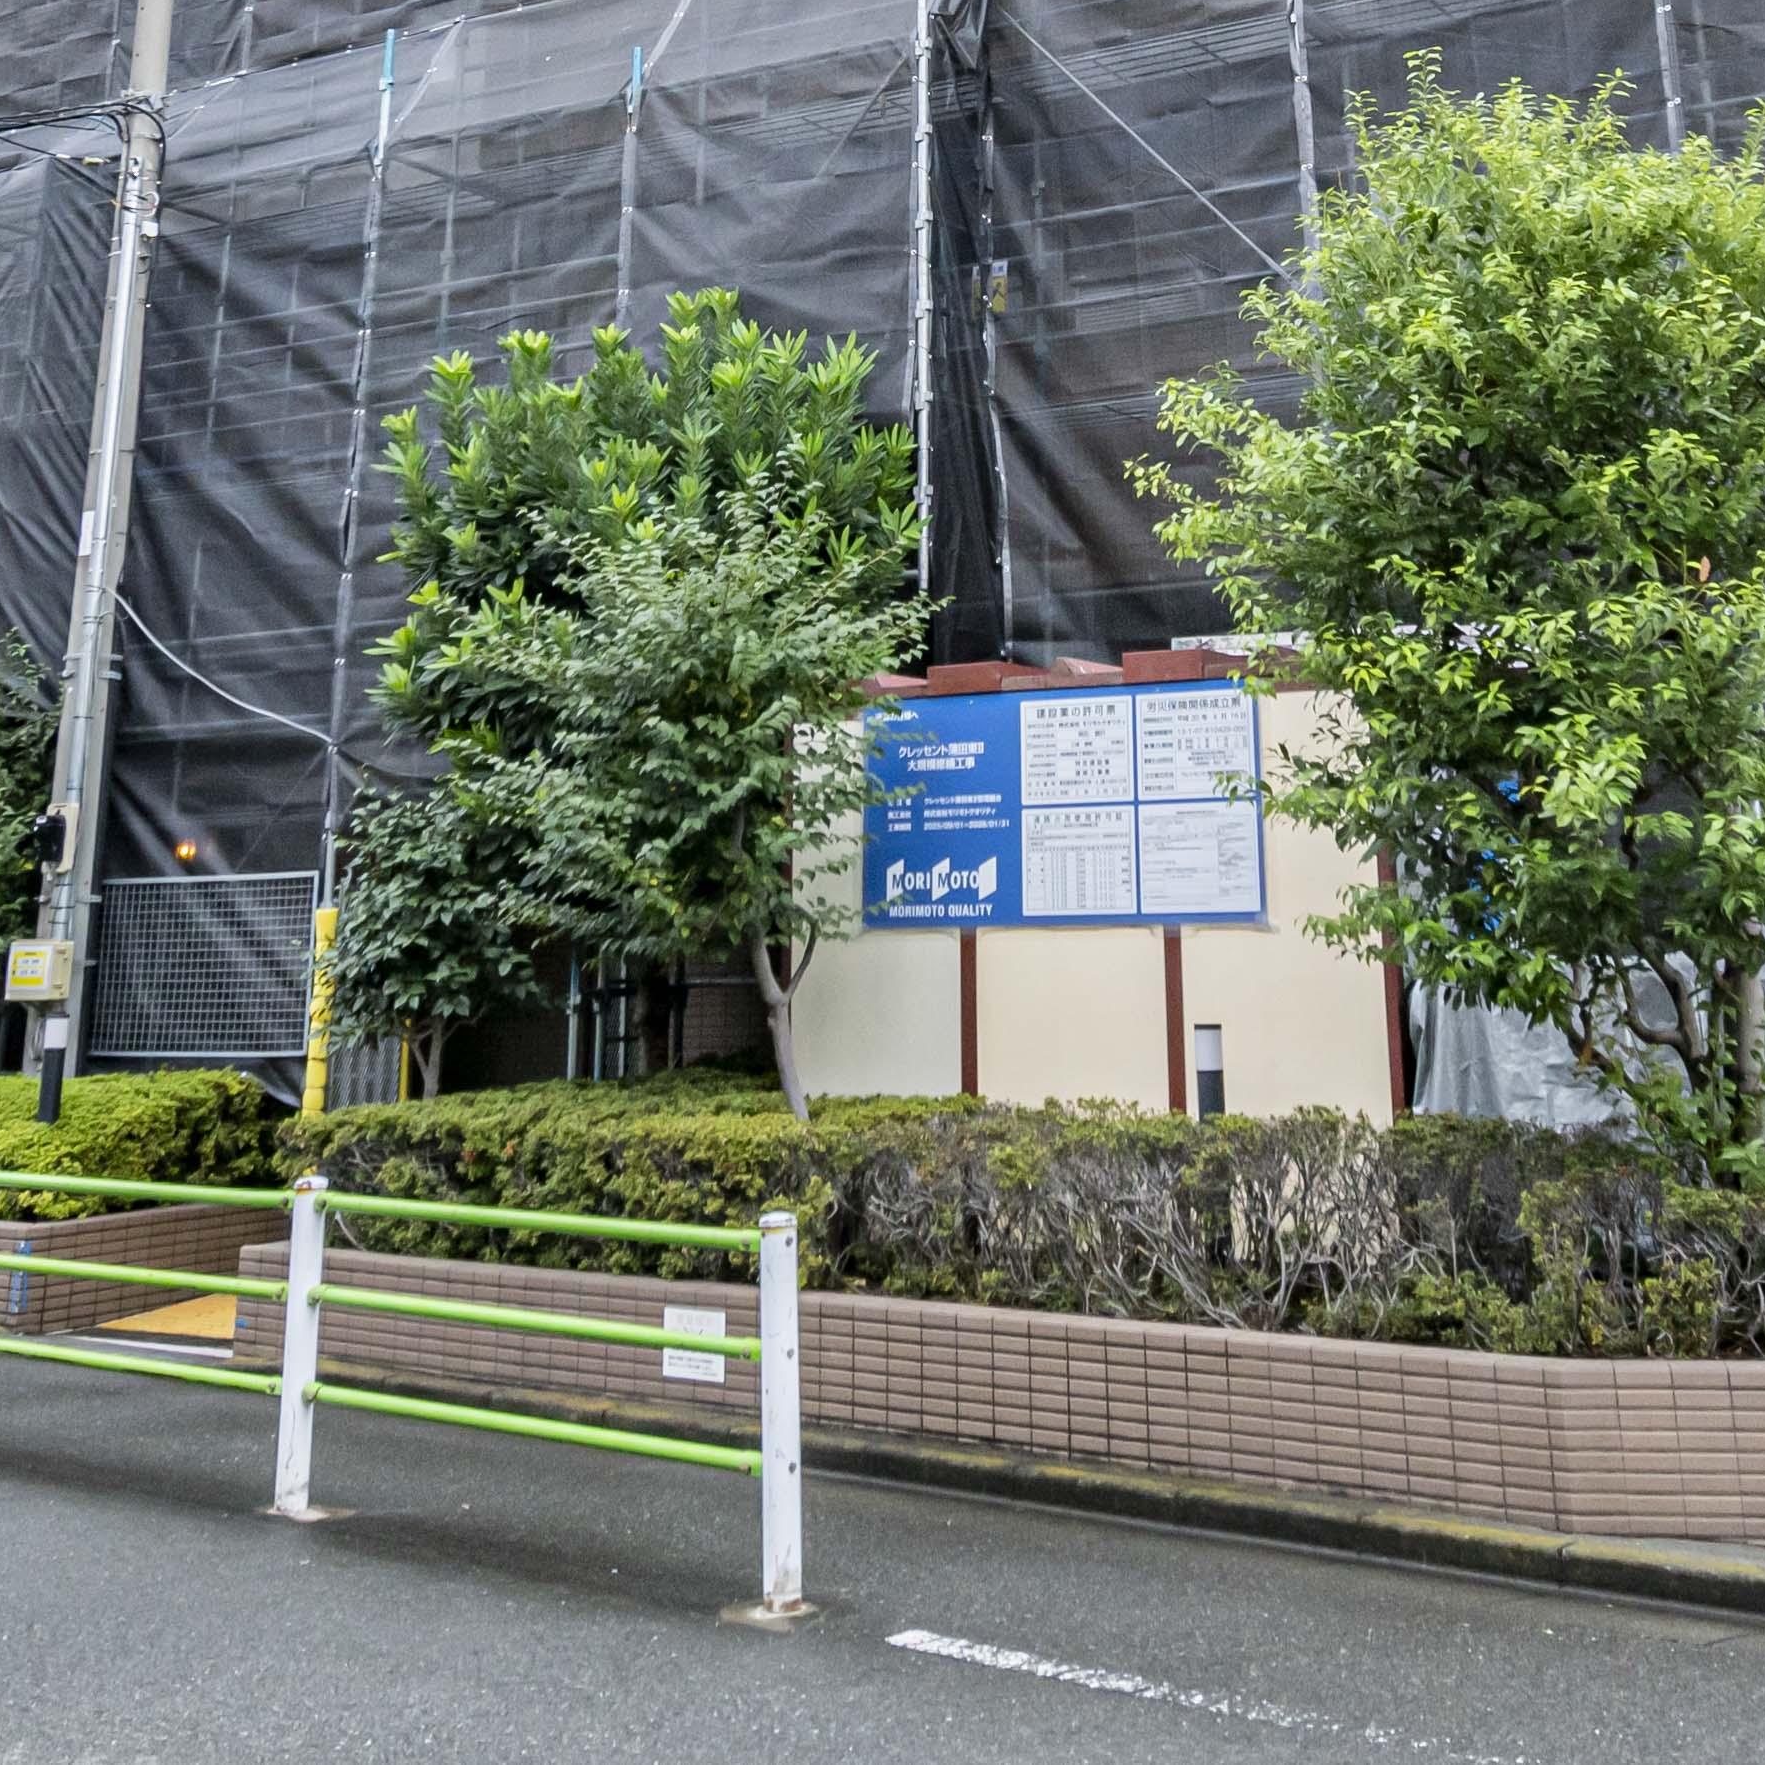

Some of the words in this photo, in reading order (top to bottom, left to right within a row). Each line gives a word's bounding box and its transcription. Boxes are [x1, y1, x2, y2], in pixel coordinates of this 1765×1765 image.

[892, 869, 980, 891] MORIMOTO
[889, 905, 945, 919] MORIMOTO
[948, 903, 993, 917] QUALITY
